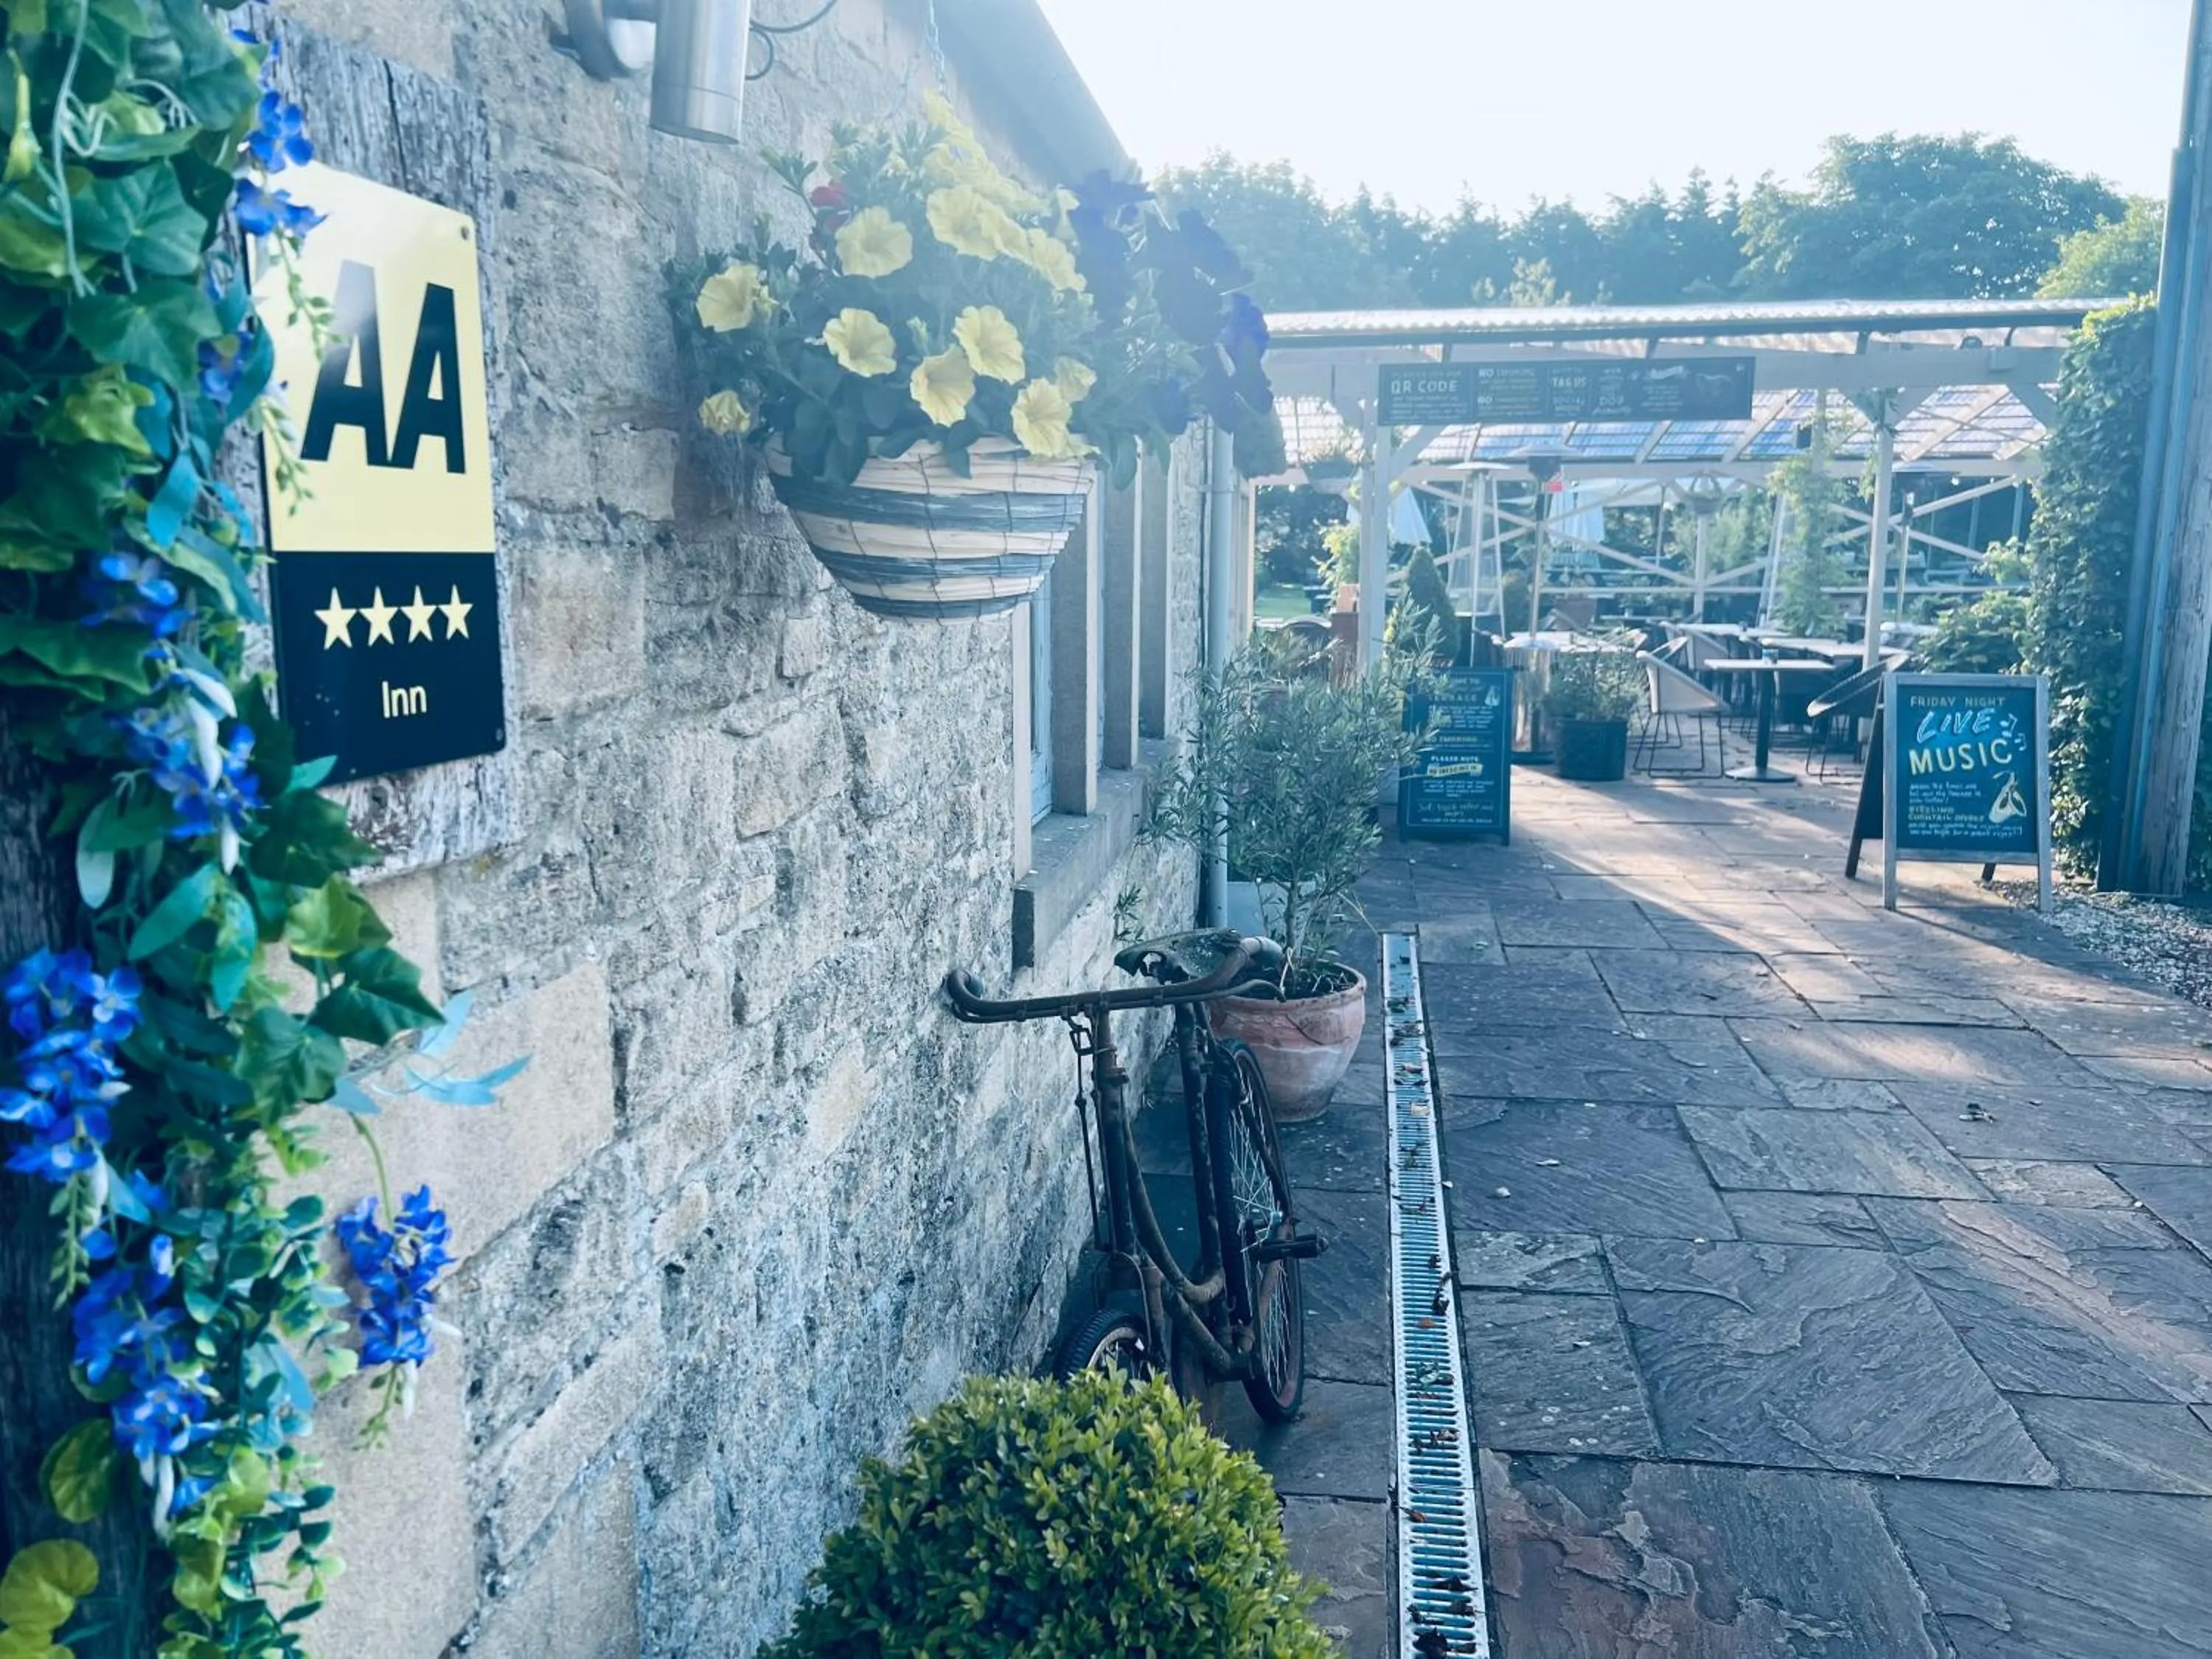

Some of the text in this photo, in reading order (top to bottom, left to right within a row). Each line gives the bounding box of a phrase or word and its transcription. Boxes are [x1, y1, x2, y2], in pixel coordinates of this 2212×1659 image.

[300, 260, 466, 474] AA
[1391, 380, 1458, 394] QR CODE
[382, 681, 427, 718] Inn
[1910, 696, 2006, 708] FRIDAY NIGHT
[1917, 708, 1995, 743] LIVE
[1909, 738, 2012, 776] MUSIC
